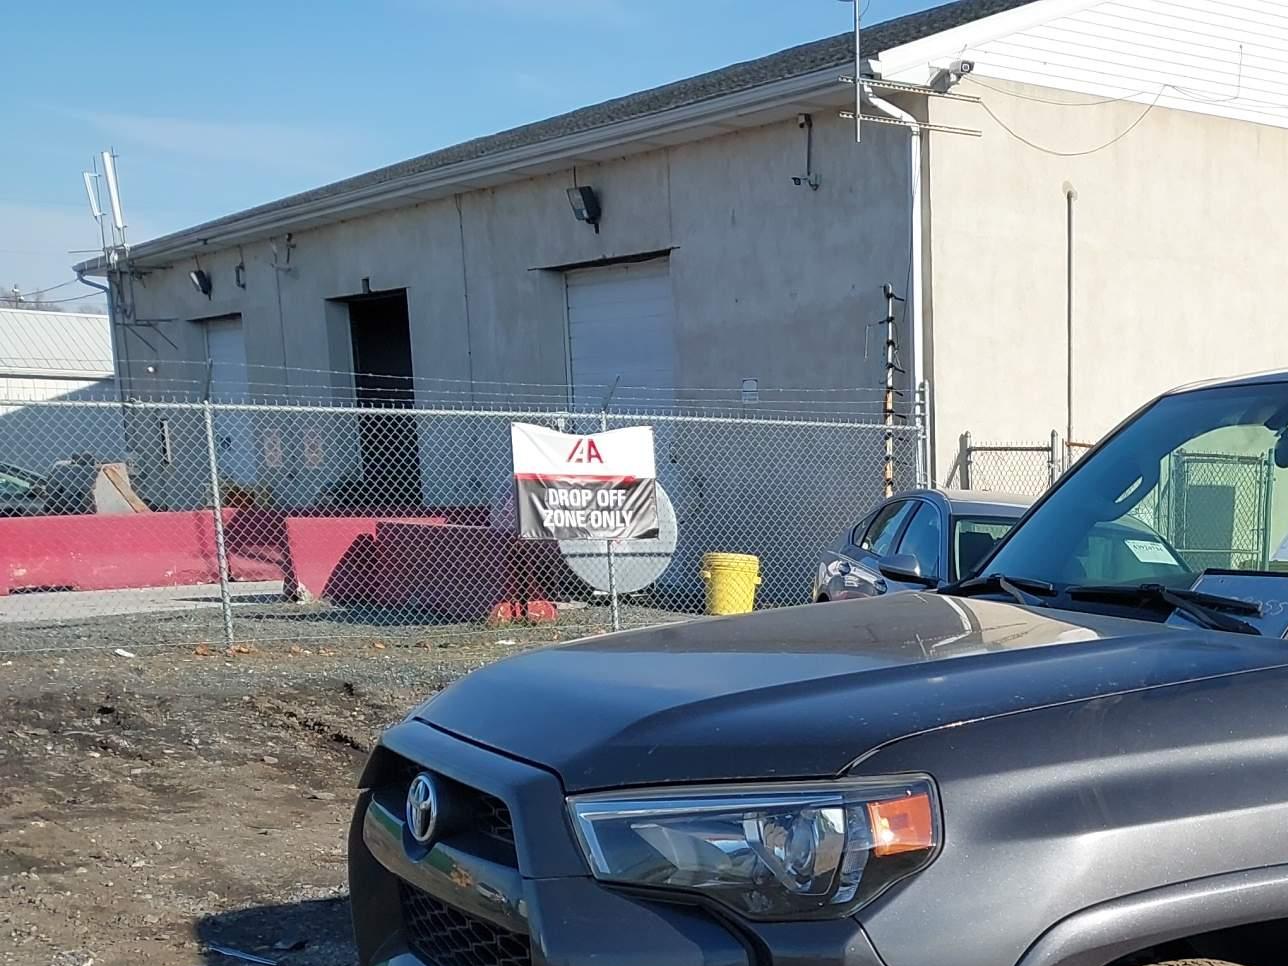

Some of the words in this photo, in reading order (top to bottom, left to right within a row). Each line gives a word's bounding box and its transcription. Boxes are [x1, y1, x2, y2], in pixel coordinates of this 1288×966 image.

[549, 489, 593, 507] DROP
[597, 489, 627, 507] OFF
[544, 510, 588, 528] ZONE
[591, 510, 634, 528] ONLY
